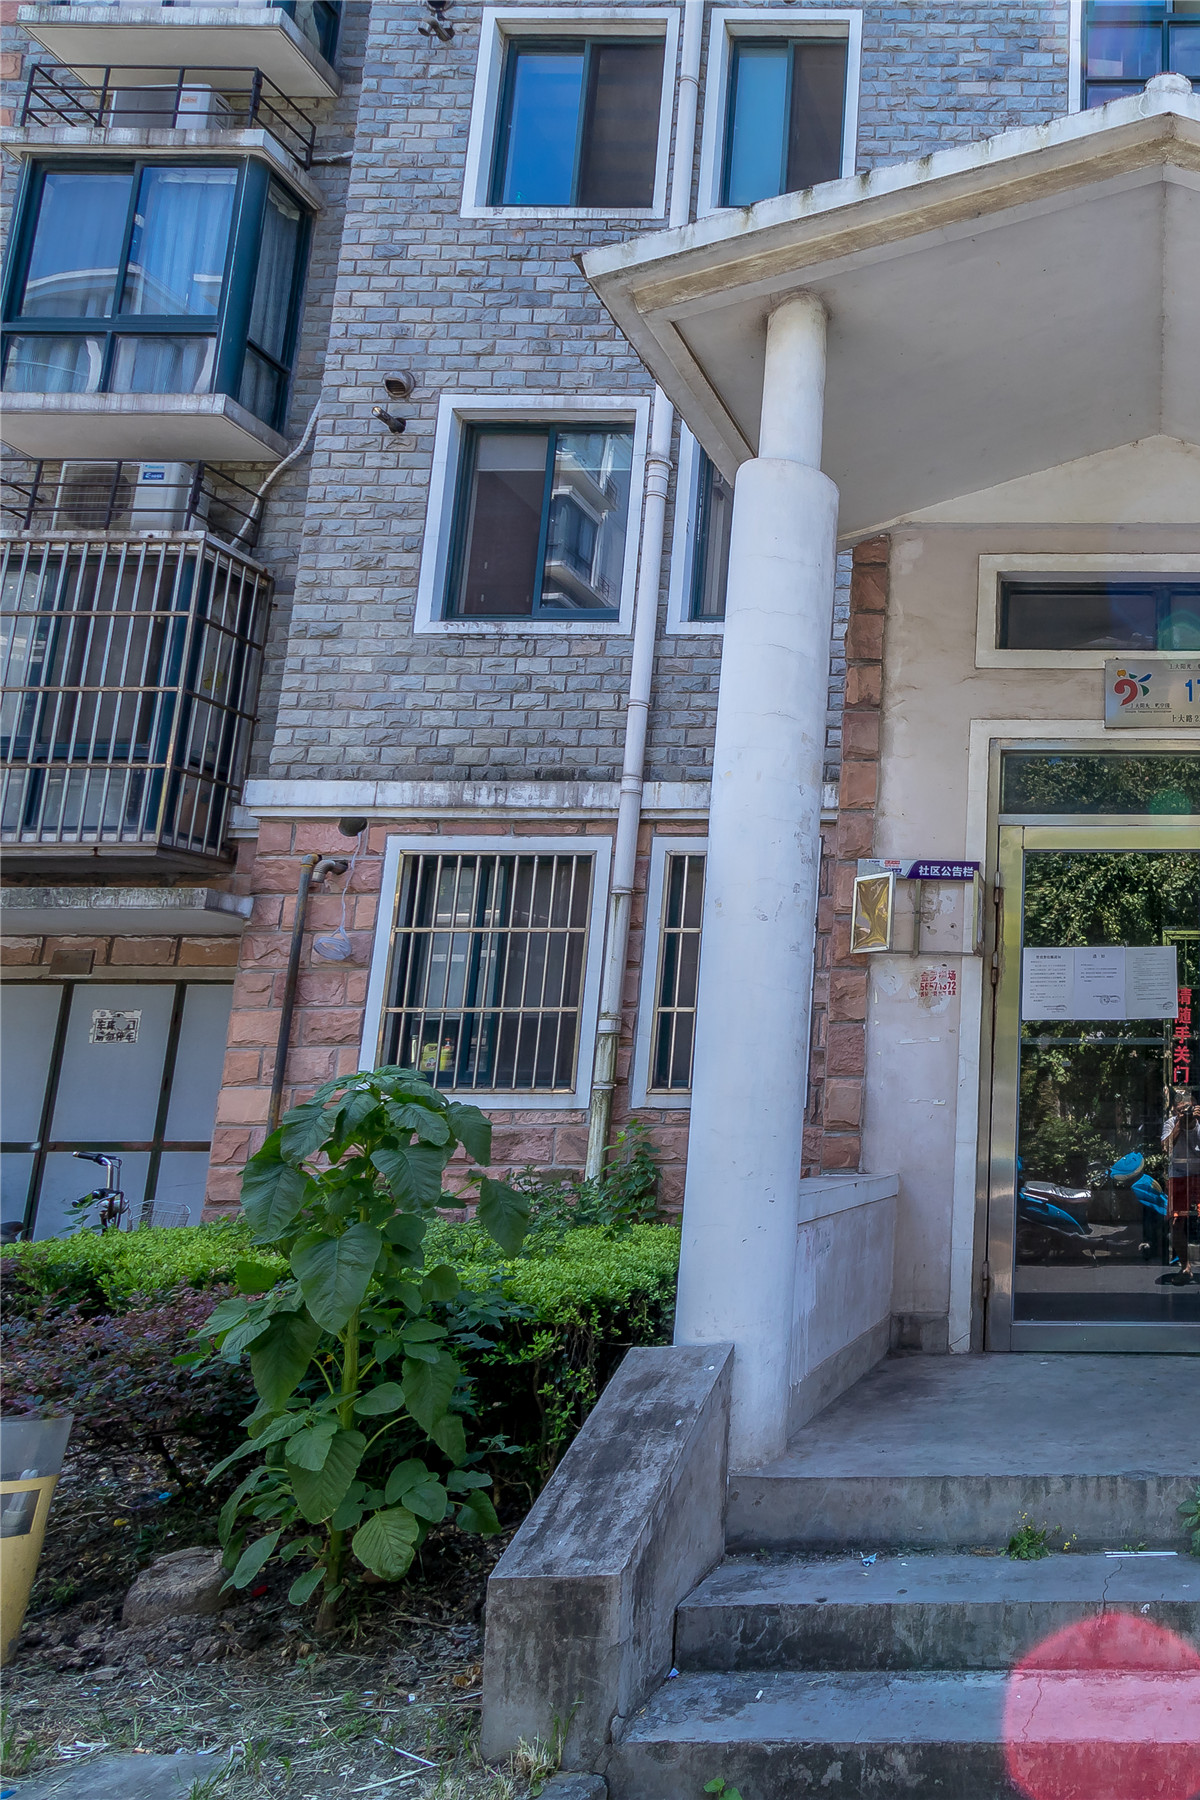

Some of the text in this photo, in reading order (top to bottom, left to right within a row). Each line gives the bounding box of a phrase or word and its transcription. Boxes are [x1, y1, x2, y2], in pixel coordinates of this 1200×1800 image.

[918, 865, 974, 877] 社区公告栏
[1173, 987, 1192, 1083] 请随手关门
